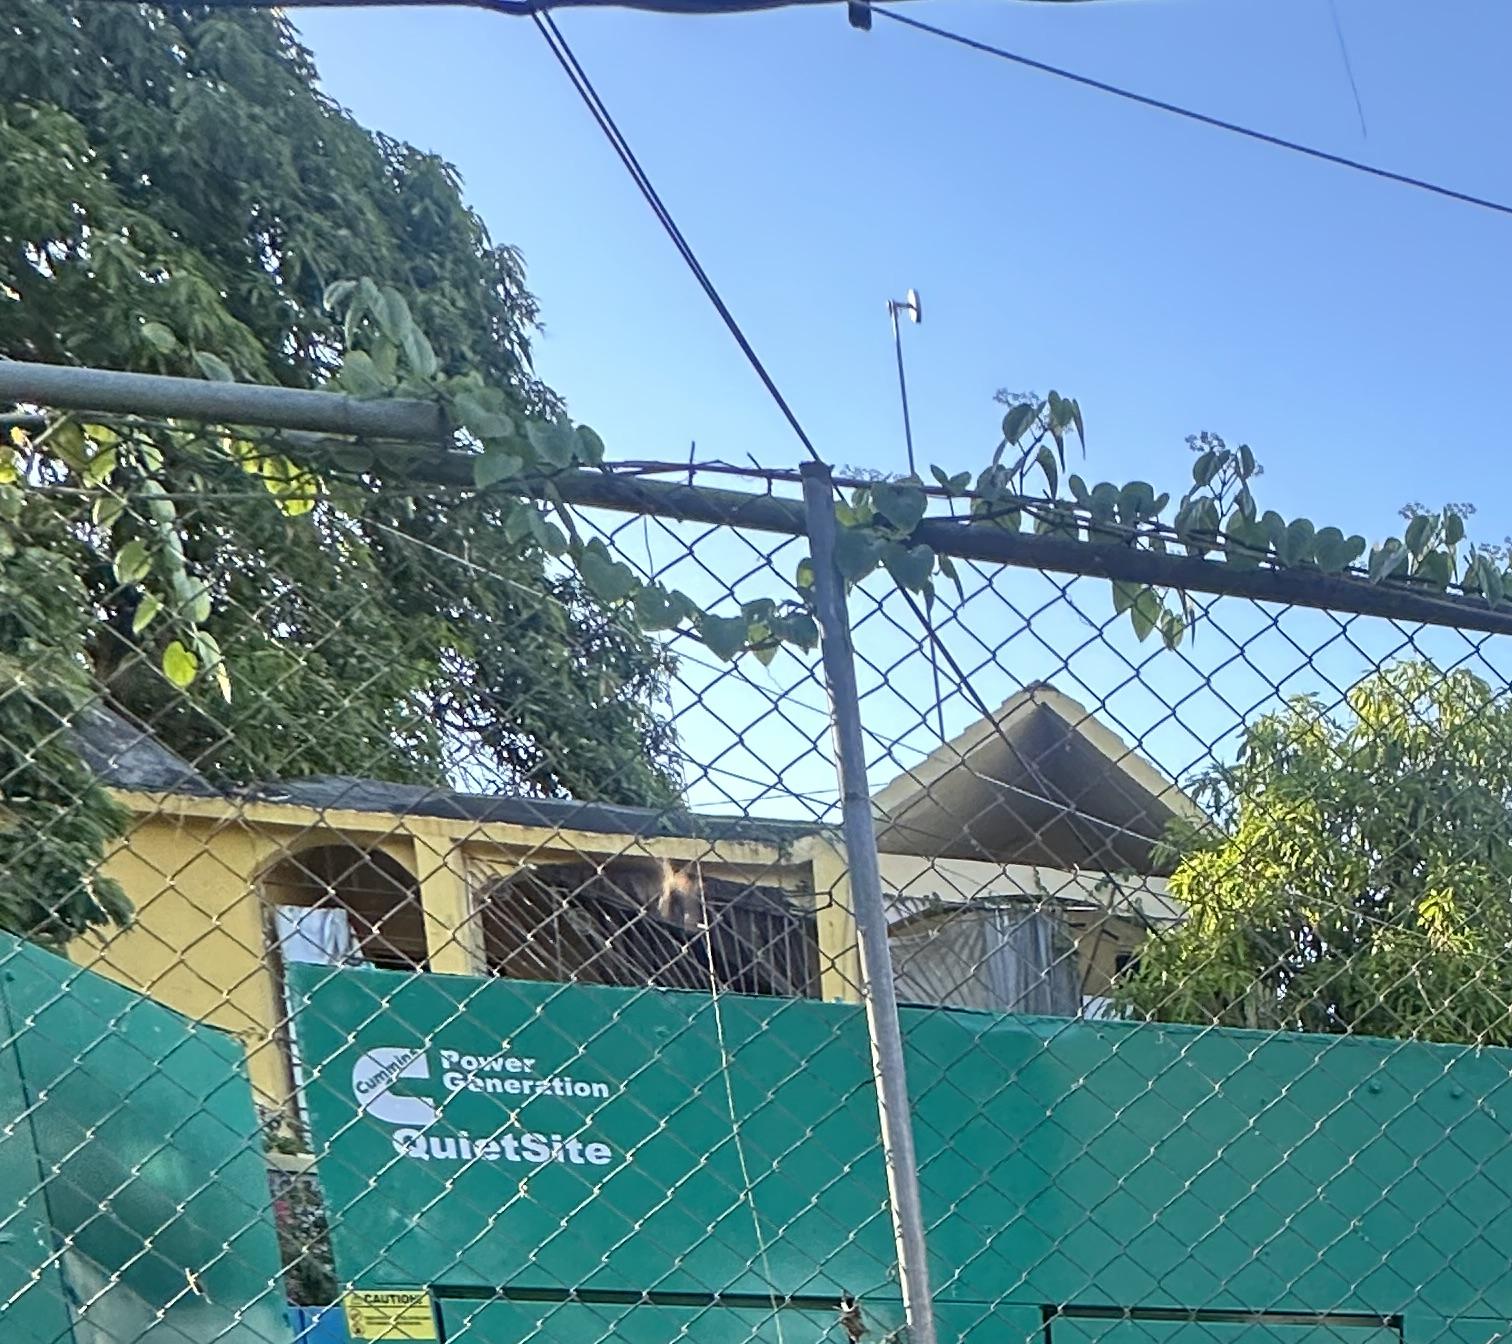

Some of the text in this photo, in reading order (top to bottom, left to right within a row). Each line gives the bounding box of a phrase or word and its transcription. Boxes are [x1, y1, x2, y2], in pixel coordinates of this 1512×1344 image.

[441, 1050, 536, 1073] Power
[442, 1072, 609, 1098] Generation
[393, 1128, 612, 1166] QuietSite
